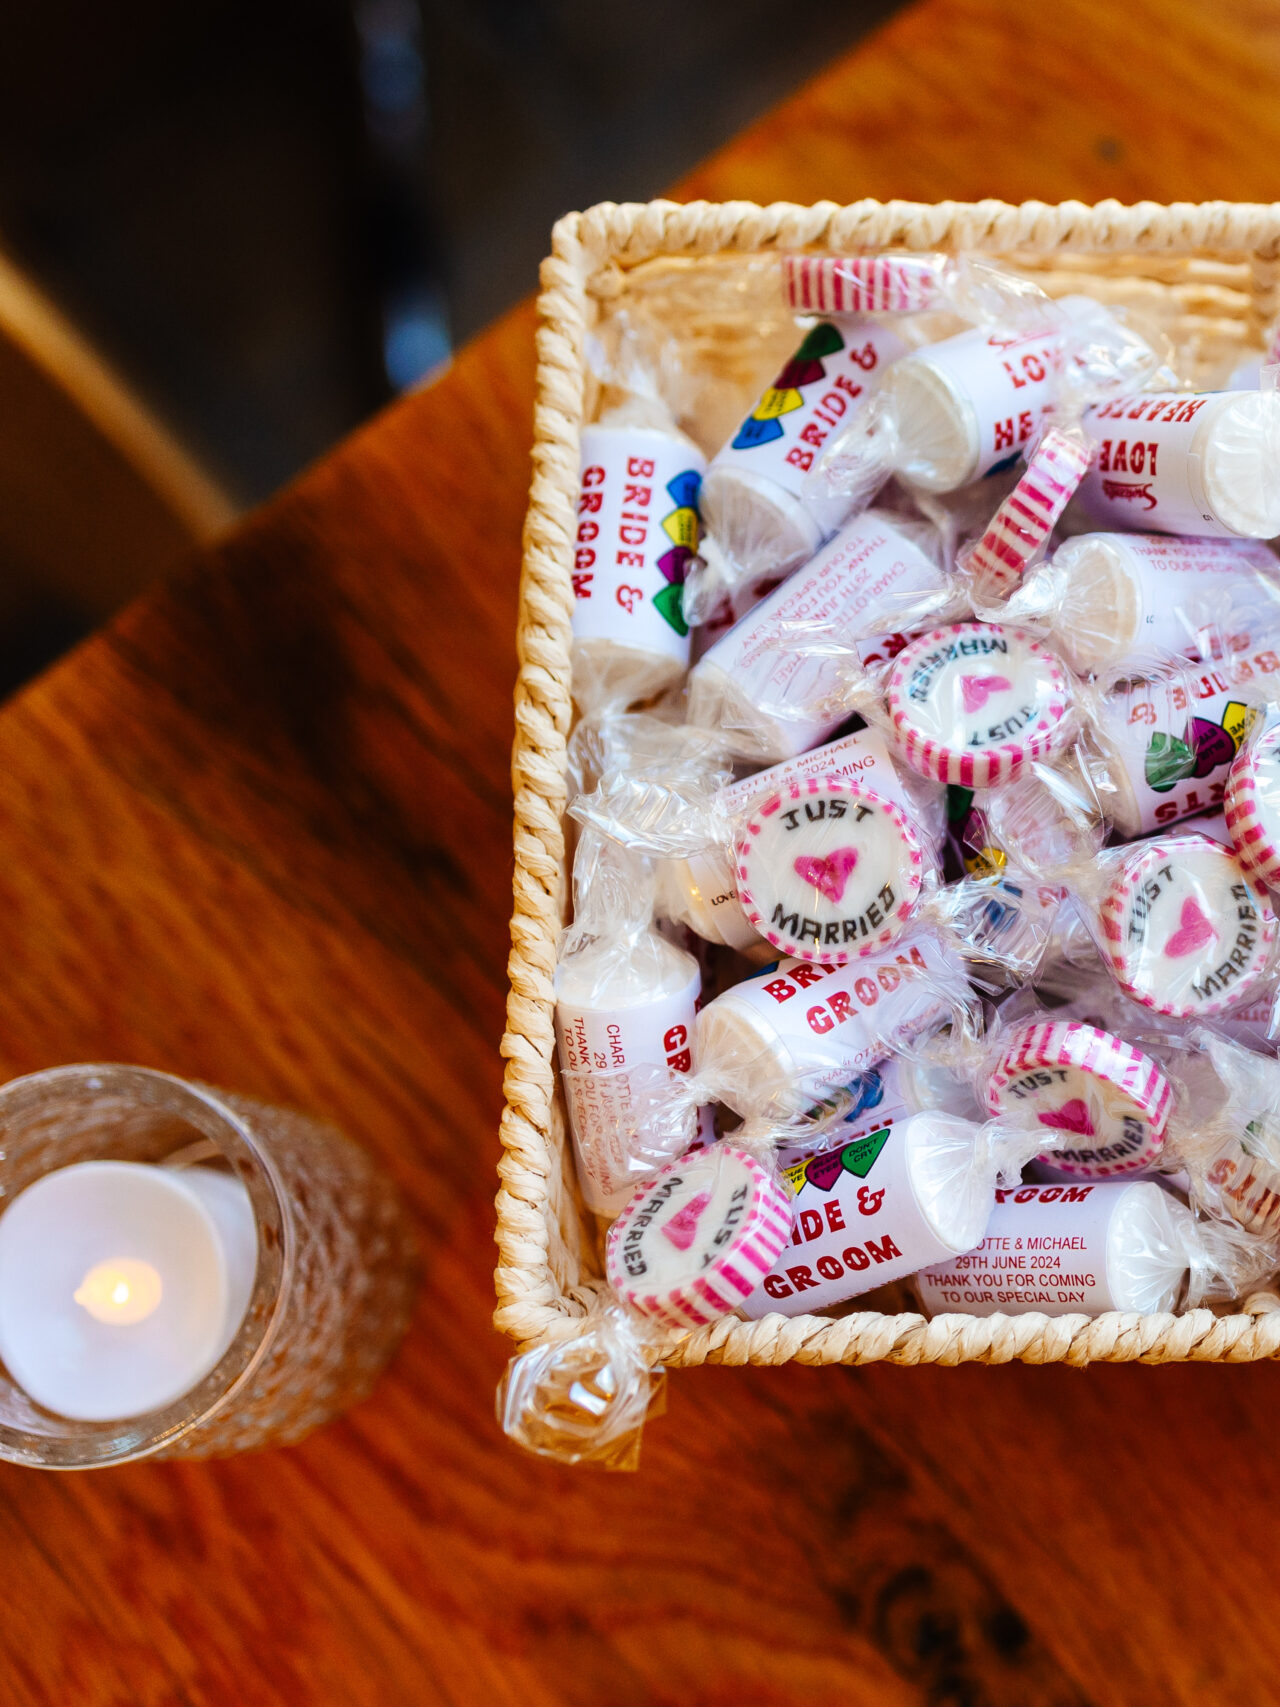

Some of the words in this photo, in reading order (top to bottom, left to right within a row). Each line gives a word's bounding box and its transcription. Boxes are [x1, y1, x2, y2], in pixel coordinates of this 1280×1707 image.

[785, 375, 863, 472] BRIDE
[849, 340, 879, 371] &
[1101, 440, 1159, 477] LOVE
[571, 464, 607, 600] GROOM
[615, 455, 656, 569] BRIDE
[614, 583, 645, 615] &
[909, 638, 1008, 703] MARRIED
[967, 704, 1040, 746] JUST
[779, 799, 874, 831] JUST
[771, 883, 896, 945] MARRIED
[1128, 863, 1176, 944] JUST
[1190, 884, 1257, 1001] MARRIED
[562, 1026, 574, 1049] TO
[572, 1016, 591, 1067] THANK
[1007, 1069, 1069, 1099] JUST
[853, 1146, 875, 1163] CRY
[1052, 1115, 1145, 1164] MARRIED
[856, 1185, 886, 1217] &
[623, 1176, 684, 1278] MARRIED
[698, 1183, 749, 1270] JUST
[1015, 1237, 1024, 1250] &
[1026, 1236, 1088, 1250] MICHAEL
[763, 1234, 904, 1300] GROOM
[925, 1274, 972, 1287] THANK
[973, 1274, 1004, 1287] YOU
[1007, 1274, 1036, 1287] FOR
[1038, 1274, 1096, 1287] COMING
[955, 1256, 988, 1270] 29TH
[992, 1256, 1026, 1270] JUNE
[1030, 1256, 1061, 1269] 2024
[940, 1291, 962, 1303] TO
[964, 1291, 995, 1304] OUR
[997, 1291, 1055, 1304] SPECIAL
[1057, 1291, 1086, 1304] DAY
